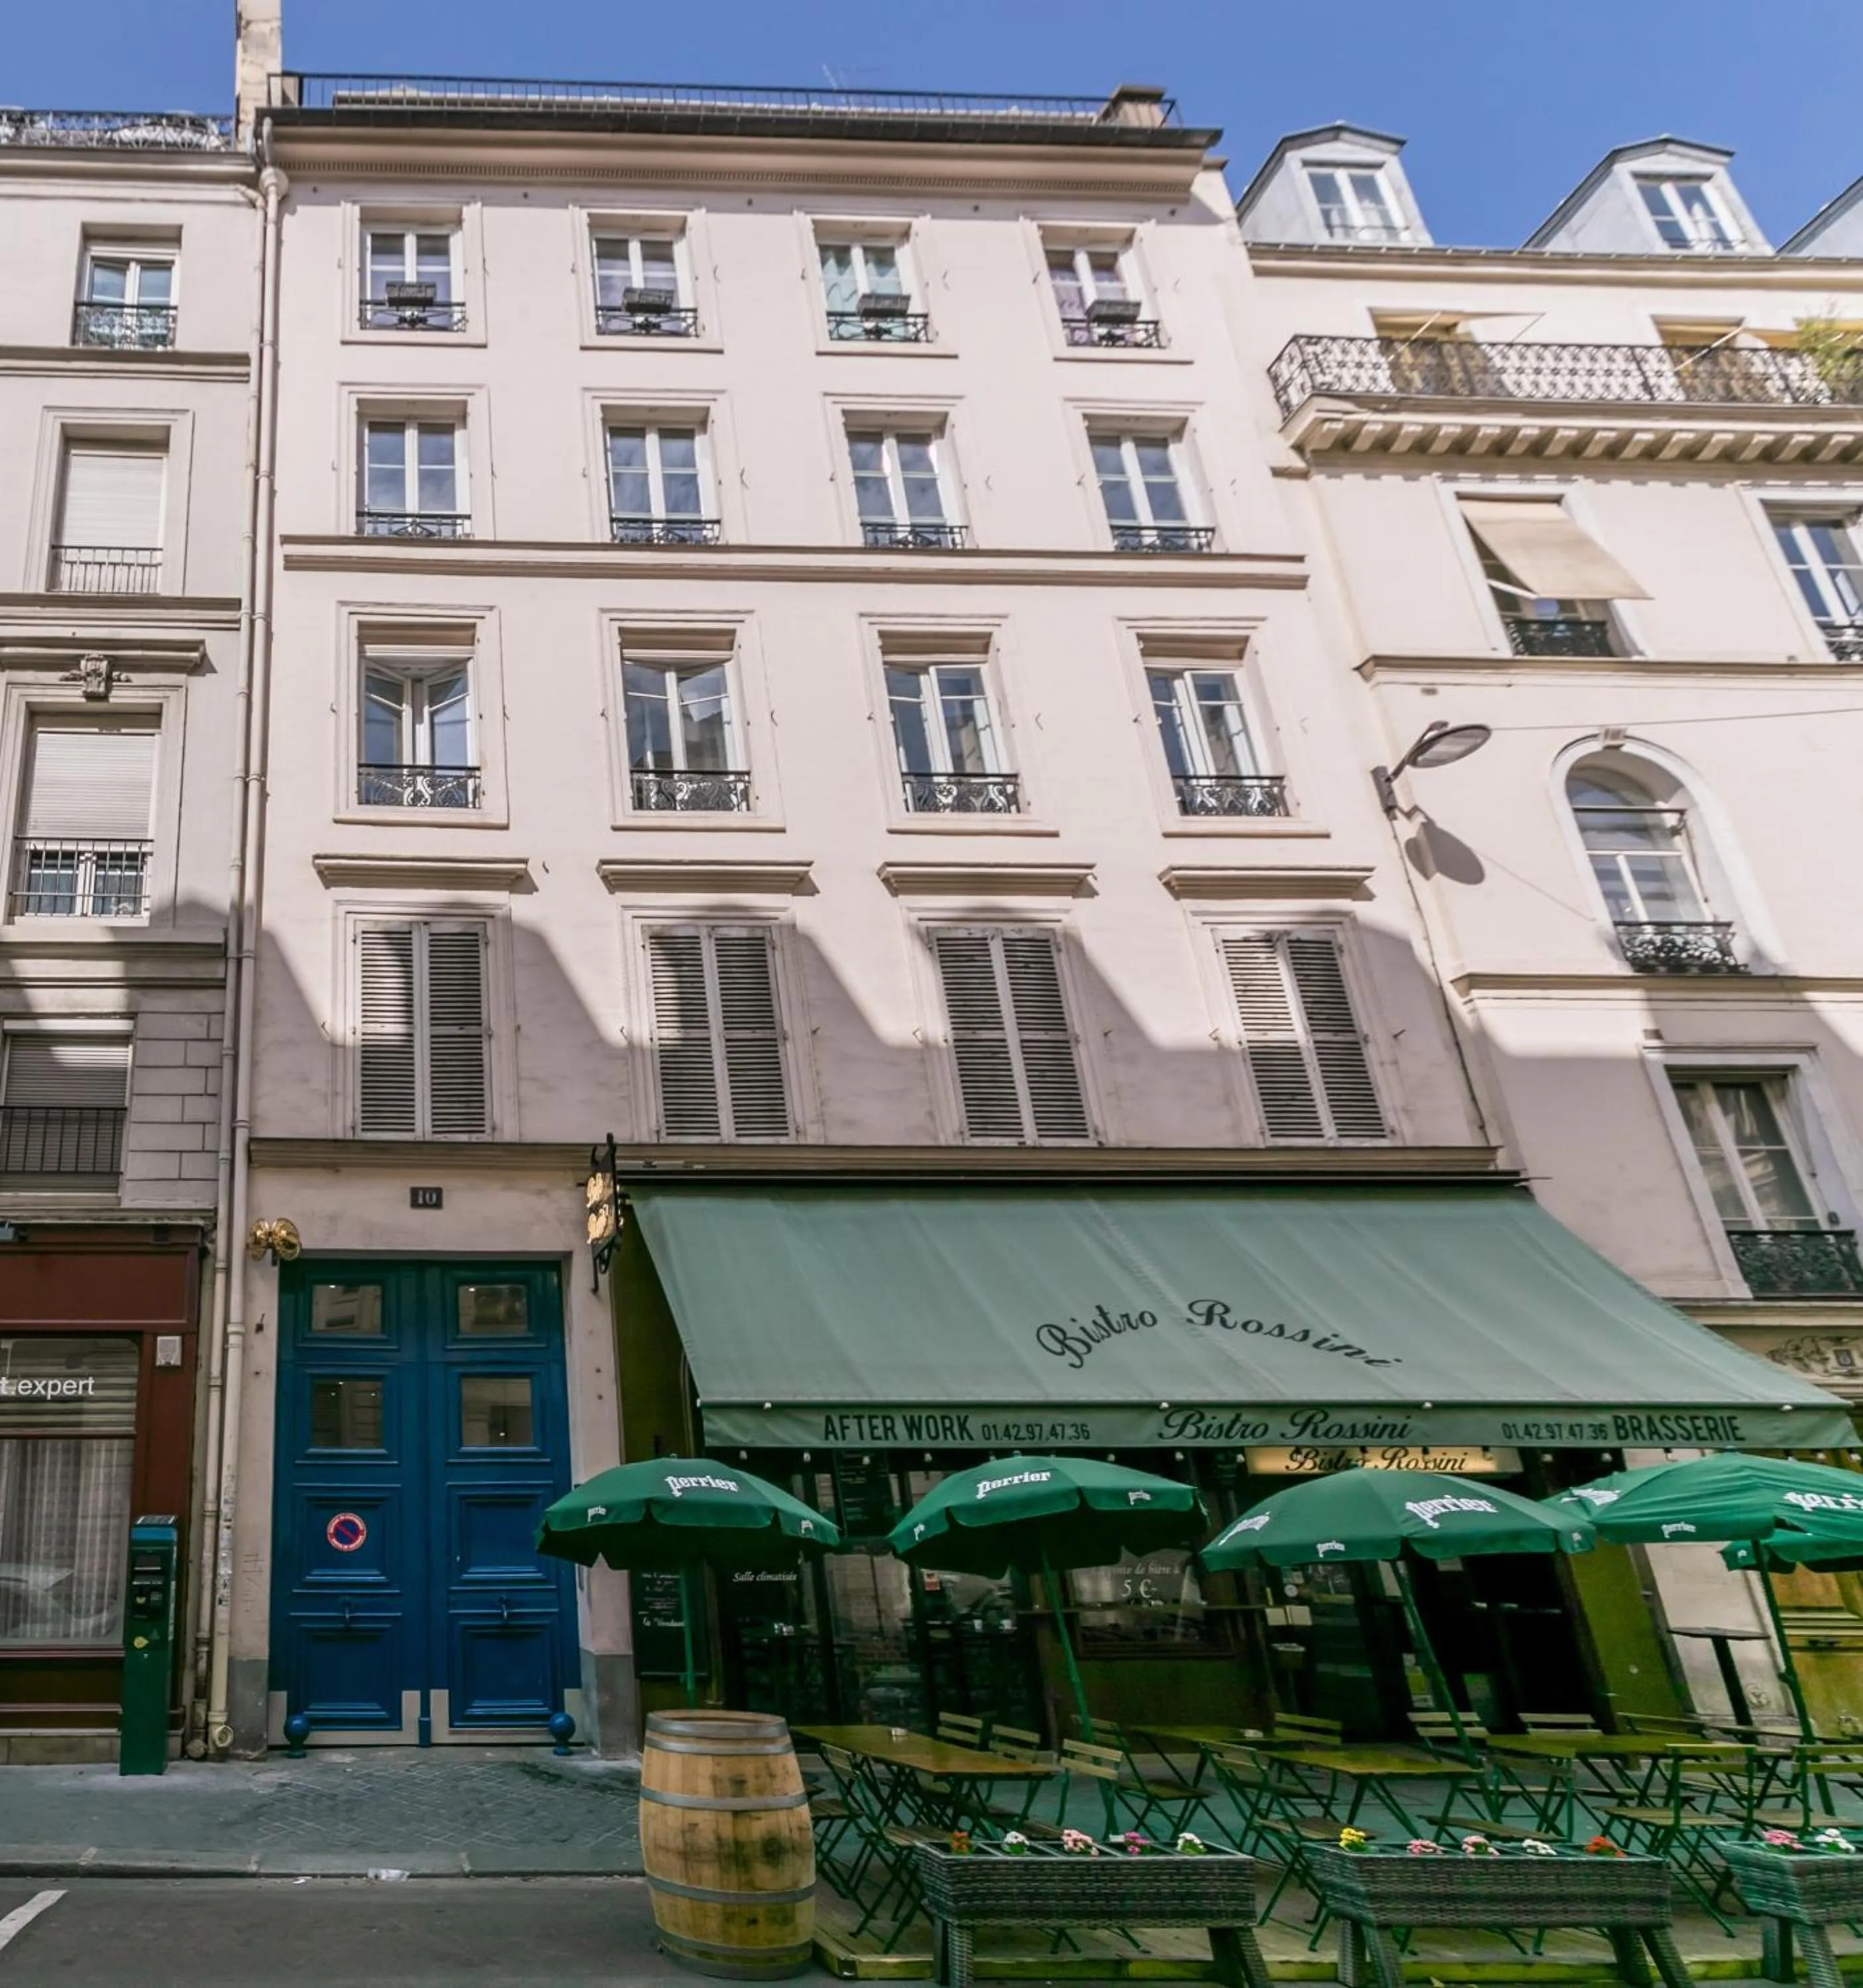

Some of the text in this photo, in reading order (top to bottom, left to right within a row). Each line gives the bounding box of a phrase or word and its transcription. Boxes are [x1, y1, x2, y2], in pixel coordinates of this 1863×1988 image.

[417, 1189, 437, 1205] 10
[1037, 1299, 1402, 1368] Bistro Rossini
[824, 1415, 897, 1441] AFTER
[902, 1415, 975, 1441] WORK
[1157, 1408, 1412, 1439] Bistro Rossini
[1611, 1415, 1745, 1441] BRASSERIE
[665, 1475, 738, 1497] perrier
[975, 1471, 1051, 1500] perrier
[1121, 1578, 1132, 1598] 5
